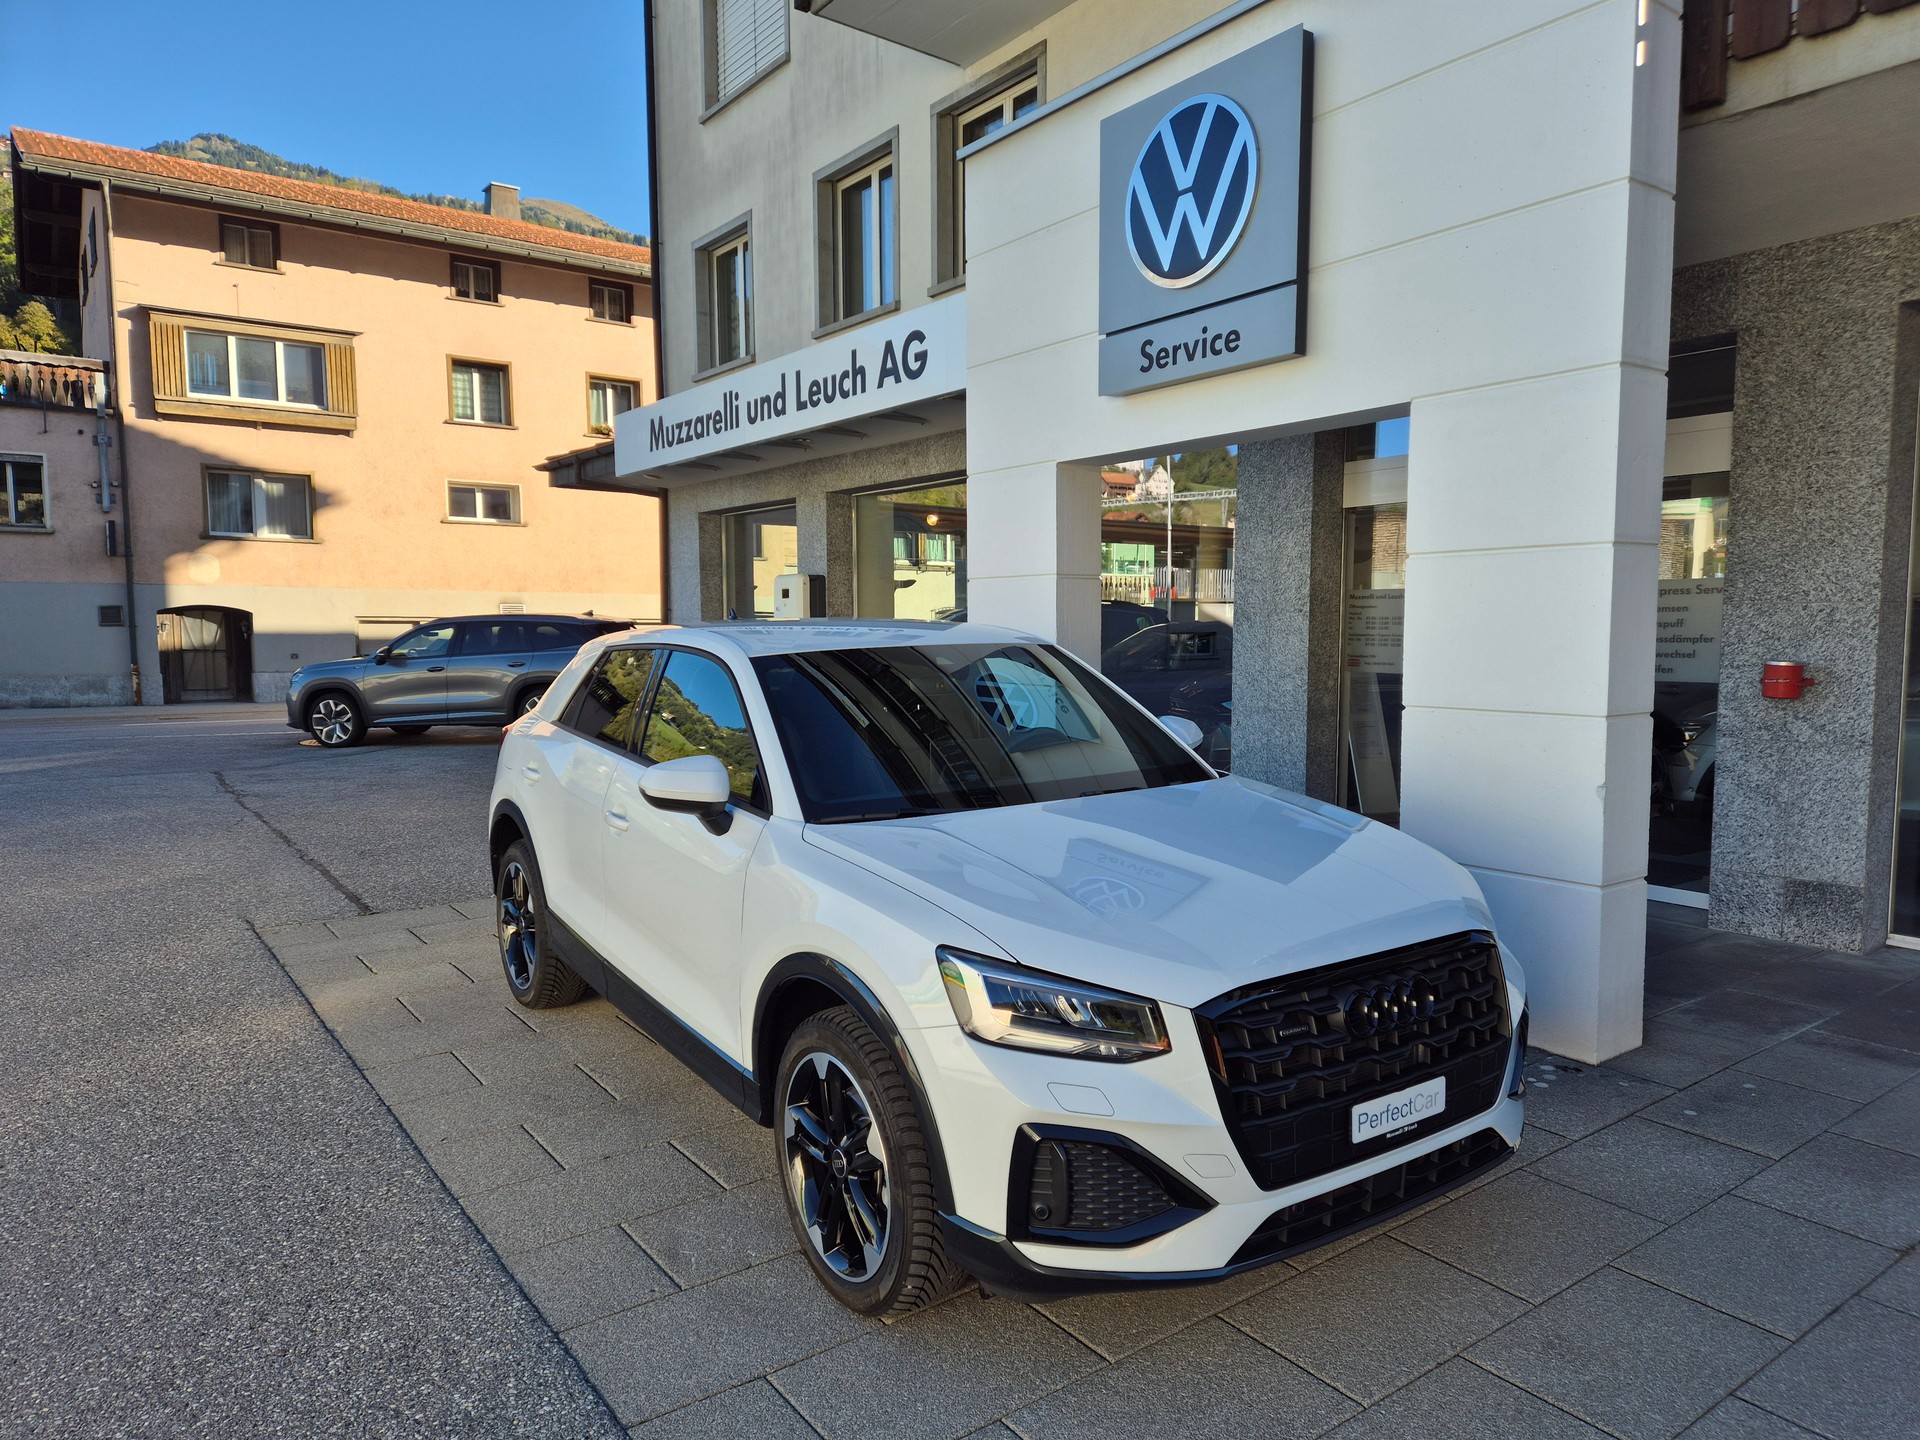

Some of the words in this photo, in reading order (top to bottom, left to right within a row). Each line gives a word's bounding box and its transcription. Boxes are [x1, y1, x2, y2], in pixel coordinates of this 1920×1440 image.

[1139, 325, 1242, 374] Service
[650, 390, 740, 452] Muzzarelli
[746, 373, 787, 425] und
[795, 349, 867, 412] Leuch
[877, 329, 929, 390] AG
[1657, 587, 1691, 598] press
[1357, 1091, 1440, 1134] PerfectCar
